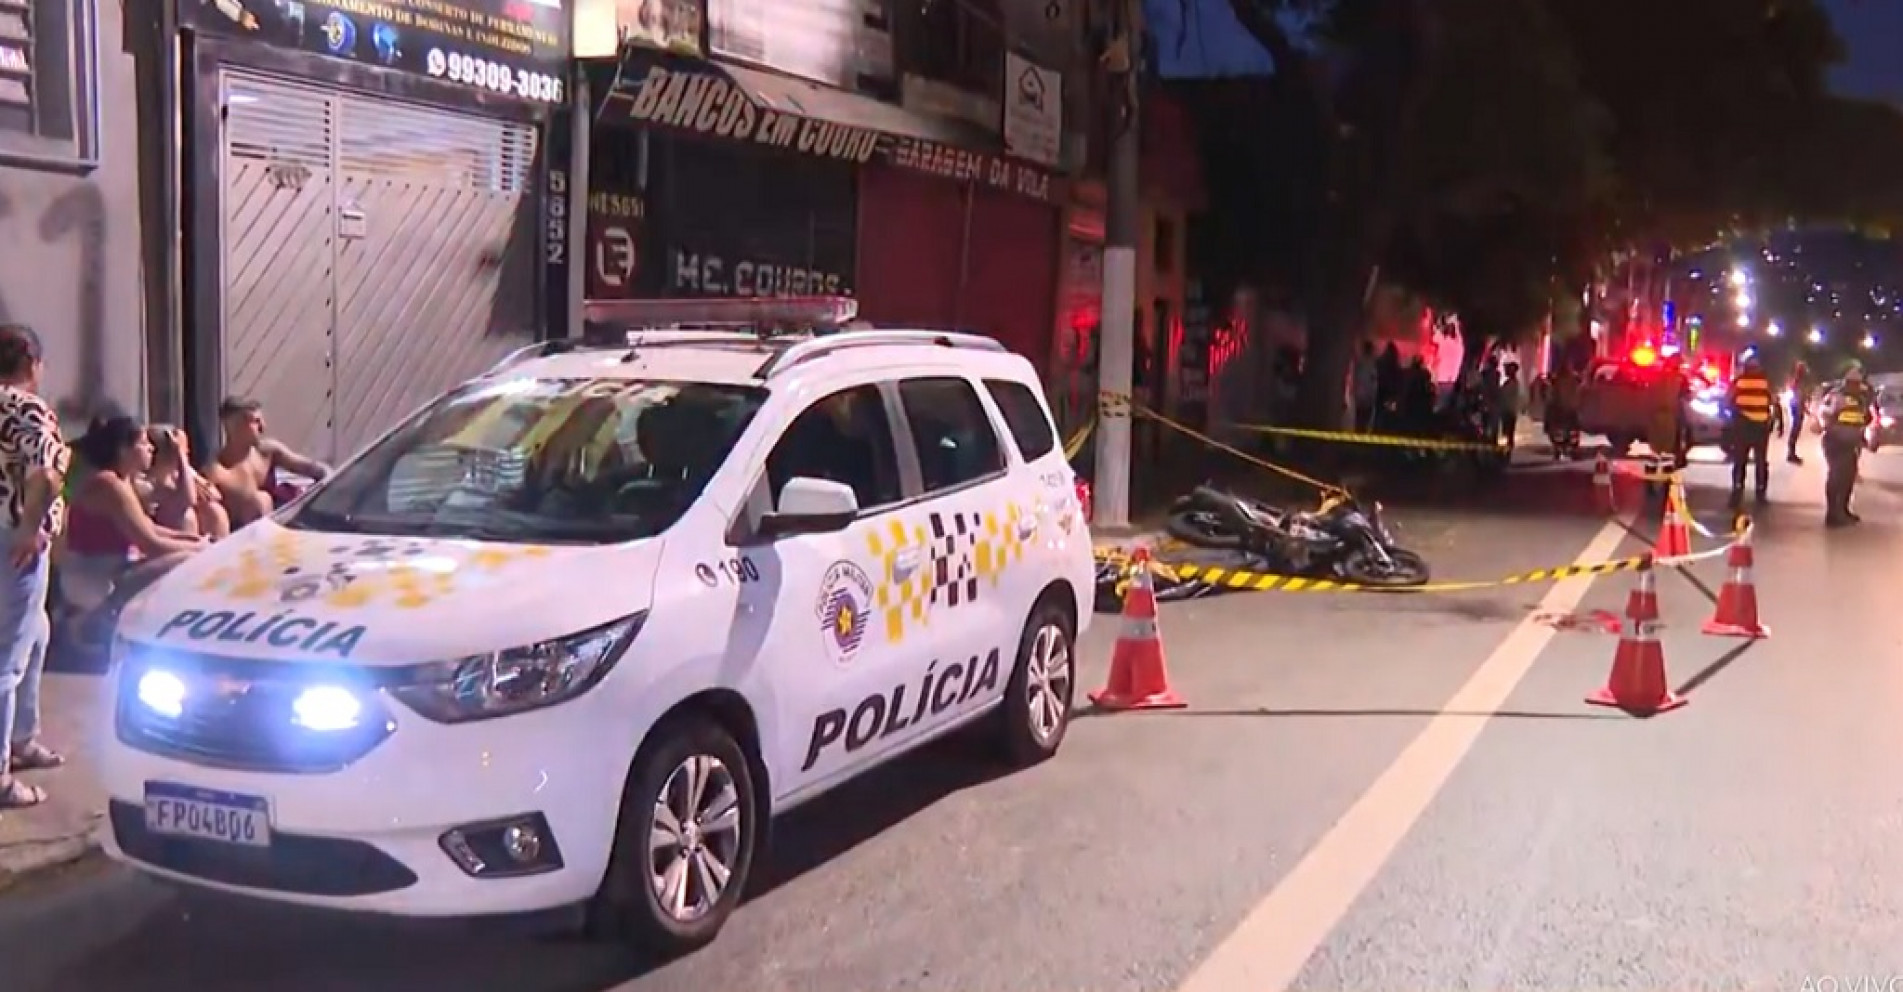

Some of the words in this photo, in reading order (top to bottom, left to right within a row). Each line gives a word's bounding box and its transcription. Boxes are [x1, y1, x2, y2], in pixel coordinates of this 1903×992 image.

[447, 52, 563, 103] 99309-3036
[630, 65, 756, 138] BANCOS
[719, 556, 759, 584] 190
[156, 609, 367, 657] POLÍCIA
[802, 647, 1000, 772] POLÍCIA
